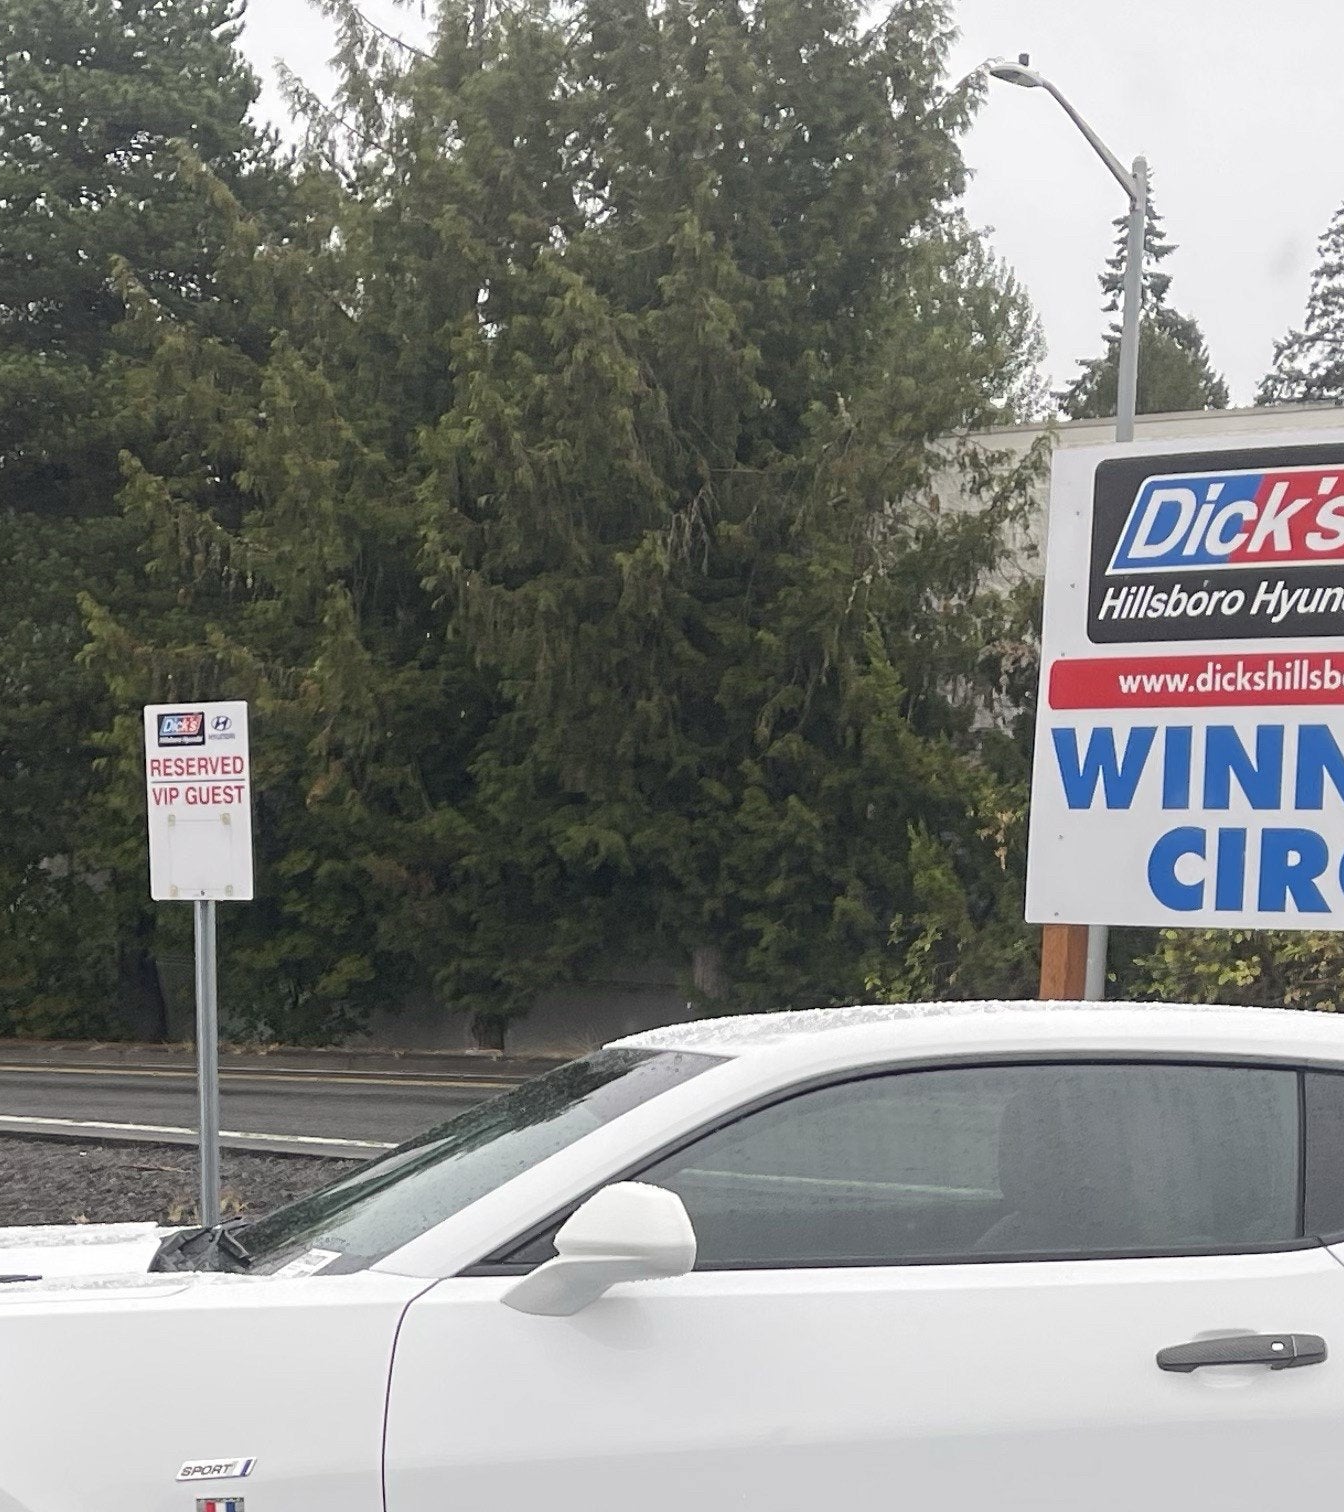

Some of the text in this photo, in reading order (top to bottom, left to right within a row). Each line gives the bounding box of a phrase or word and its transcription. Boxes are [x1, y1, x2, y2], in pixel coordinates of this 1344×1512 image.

[1098, 583, 1244, 621] Hillsboro
[150, 756, 244, 777] RESERVED
[152, 785, 245, 805] VIP GUEST
[181, 1464, 233, 1477] SPORT
